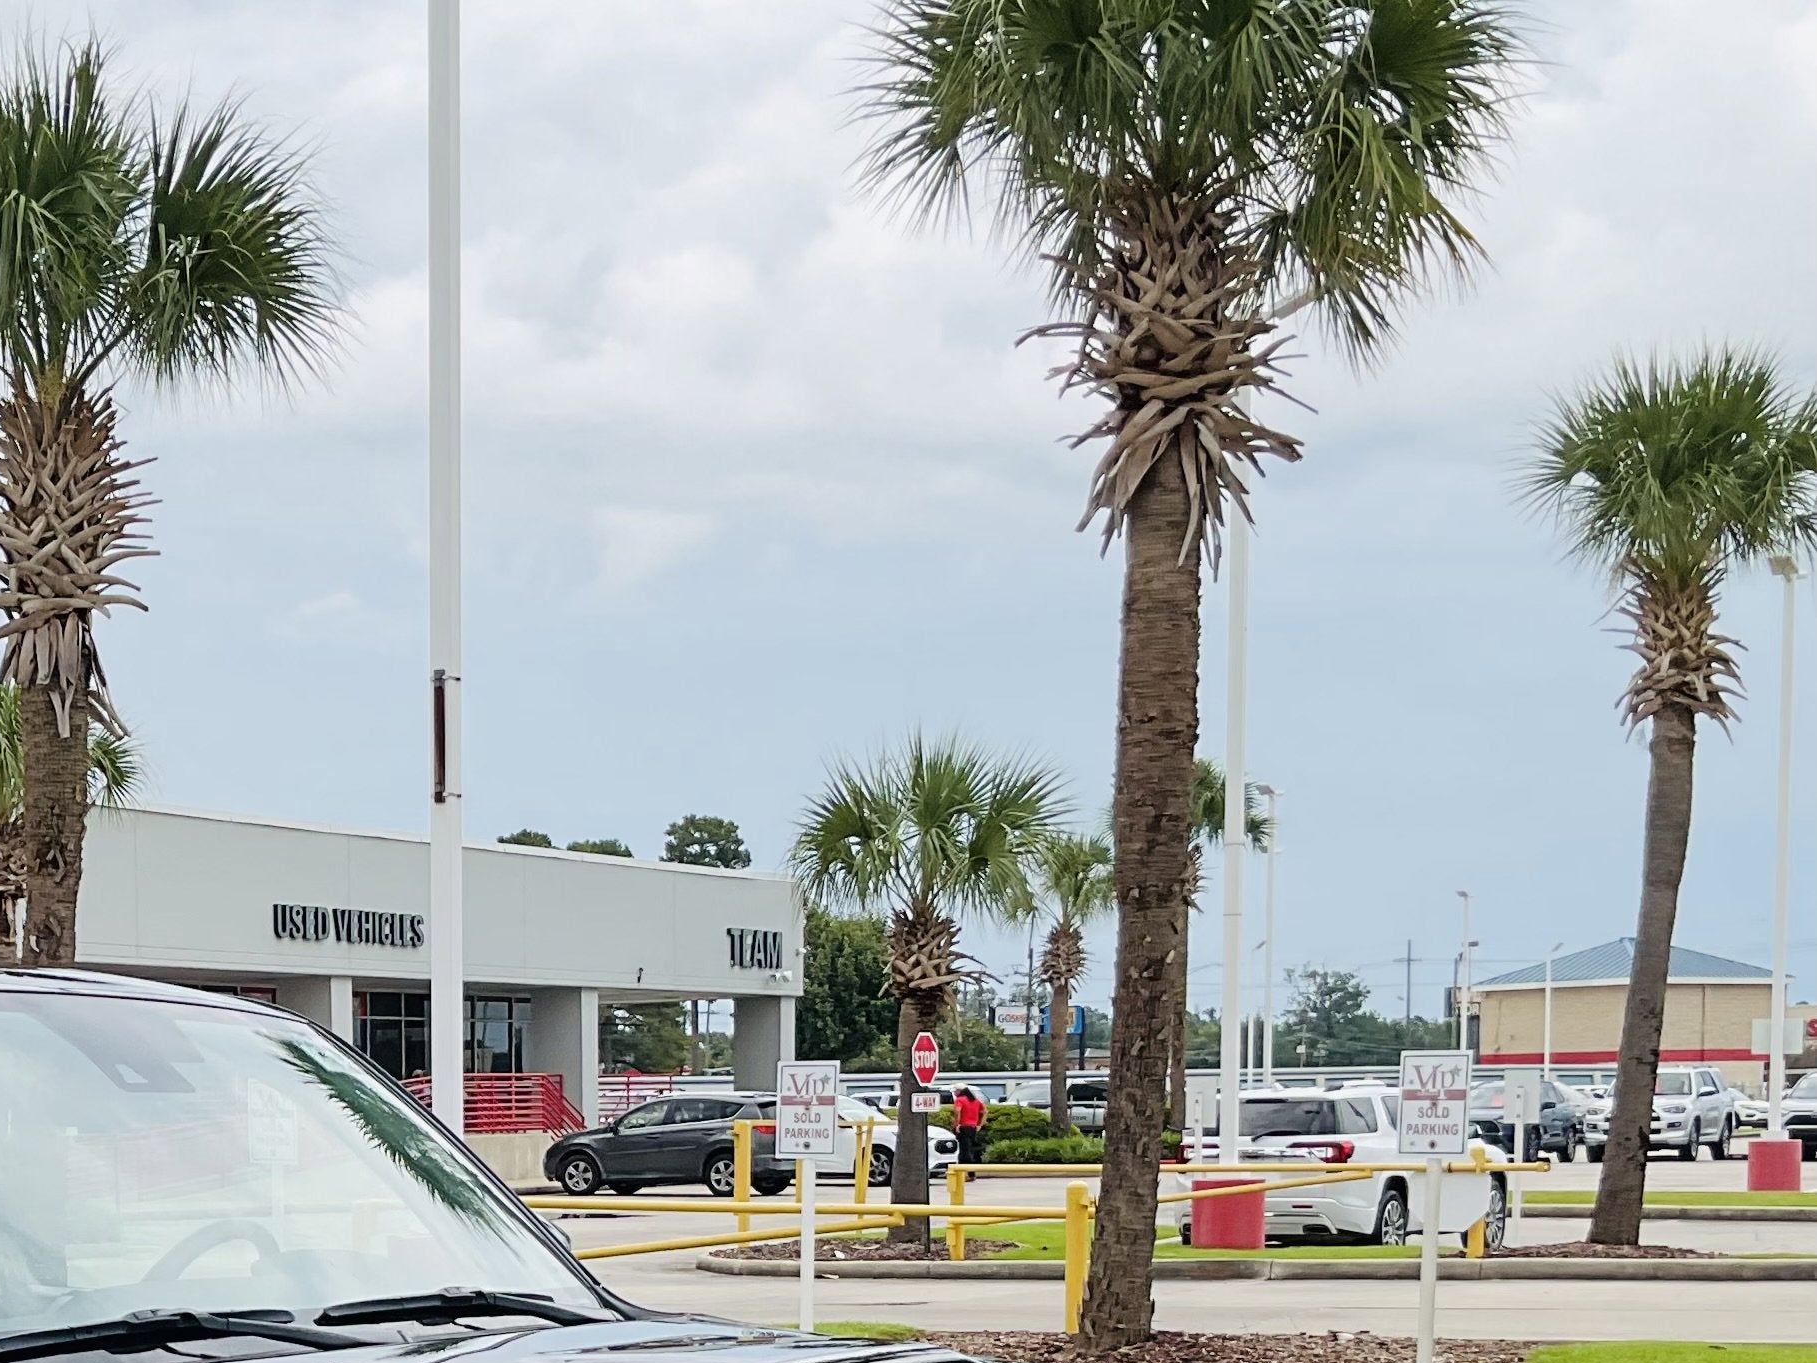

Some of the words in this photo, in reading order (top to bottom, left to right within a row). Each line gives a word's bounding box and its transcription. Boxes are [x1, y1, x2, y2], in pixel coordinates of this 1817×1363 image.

[273, 904, 330, 941] USED
[332, 908, 425, 948] VEHICLES
[727, 928, 783, 969] TEAM
[914, 1050, 936, 1069] STOP
[915, 1096, 937, 1108] 4-WAY
[793, 1112, 821, 1124] SOLD
[1417, 1106, 1450, 1119] SOLD
[784, 1127, 830, 1139] PARKING
[1405, 1123, 1459, 1136] PARKING
